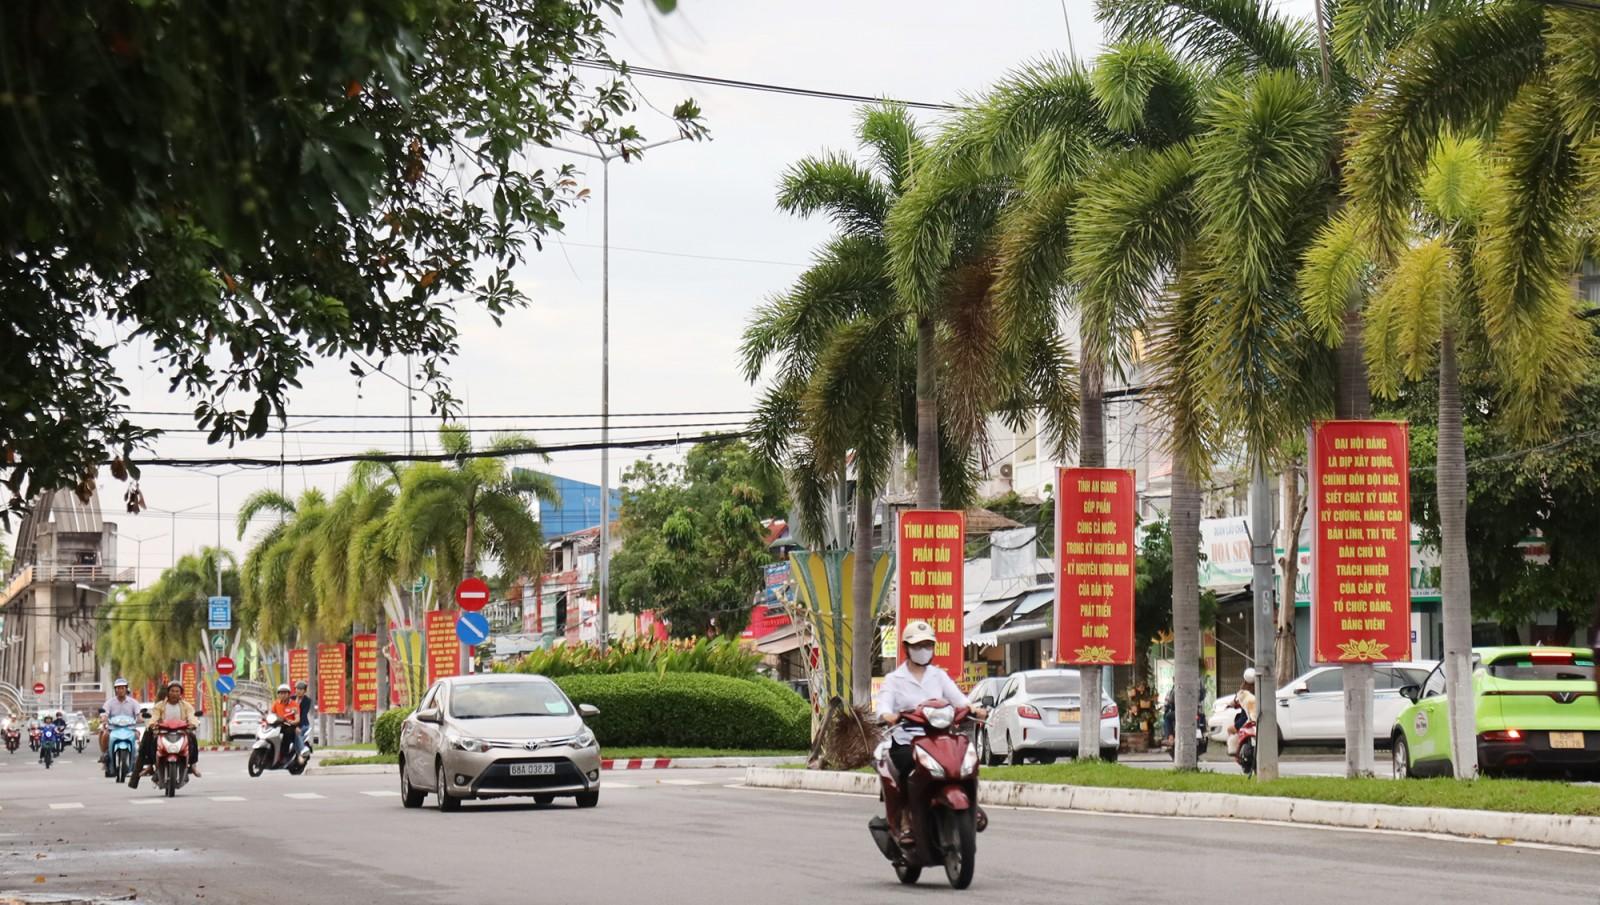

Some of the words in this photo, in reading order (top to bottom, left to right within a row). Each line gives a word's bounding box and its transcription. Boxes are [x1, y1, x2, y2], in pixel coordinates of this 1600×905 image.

[1092, 480, 1099, 492] AN
[1387, 510, 1403, 522] CAO
[924, 524, 934, 538] AN
[936, 524, 959, 539] GIANG
